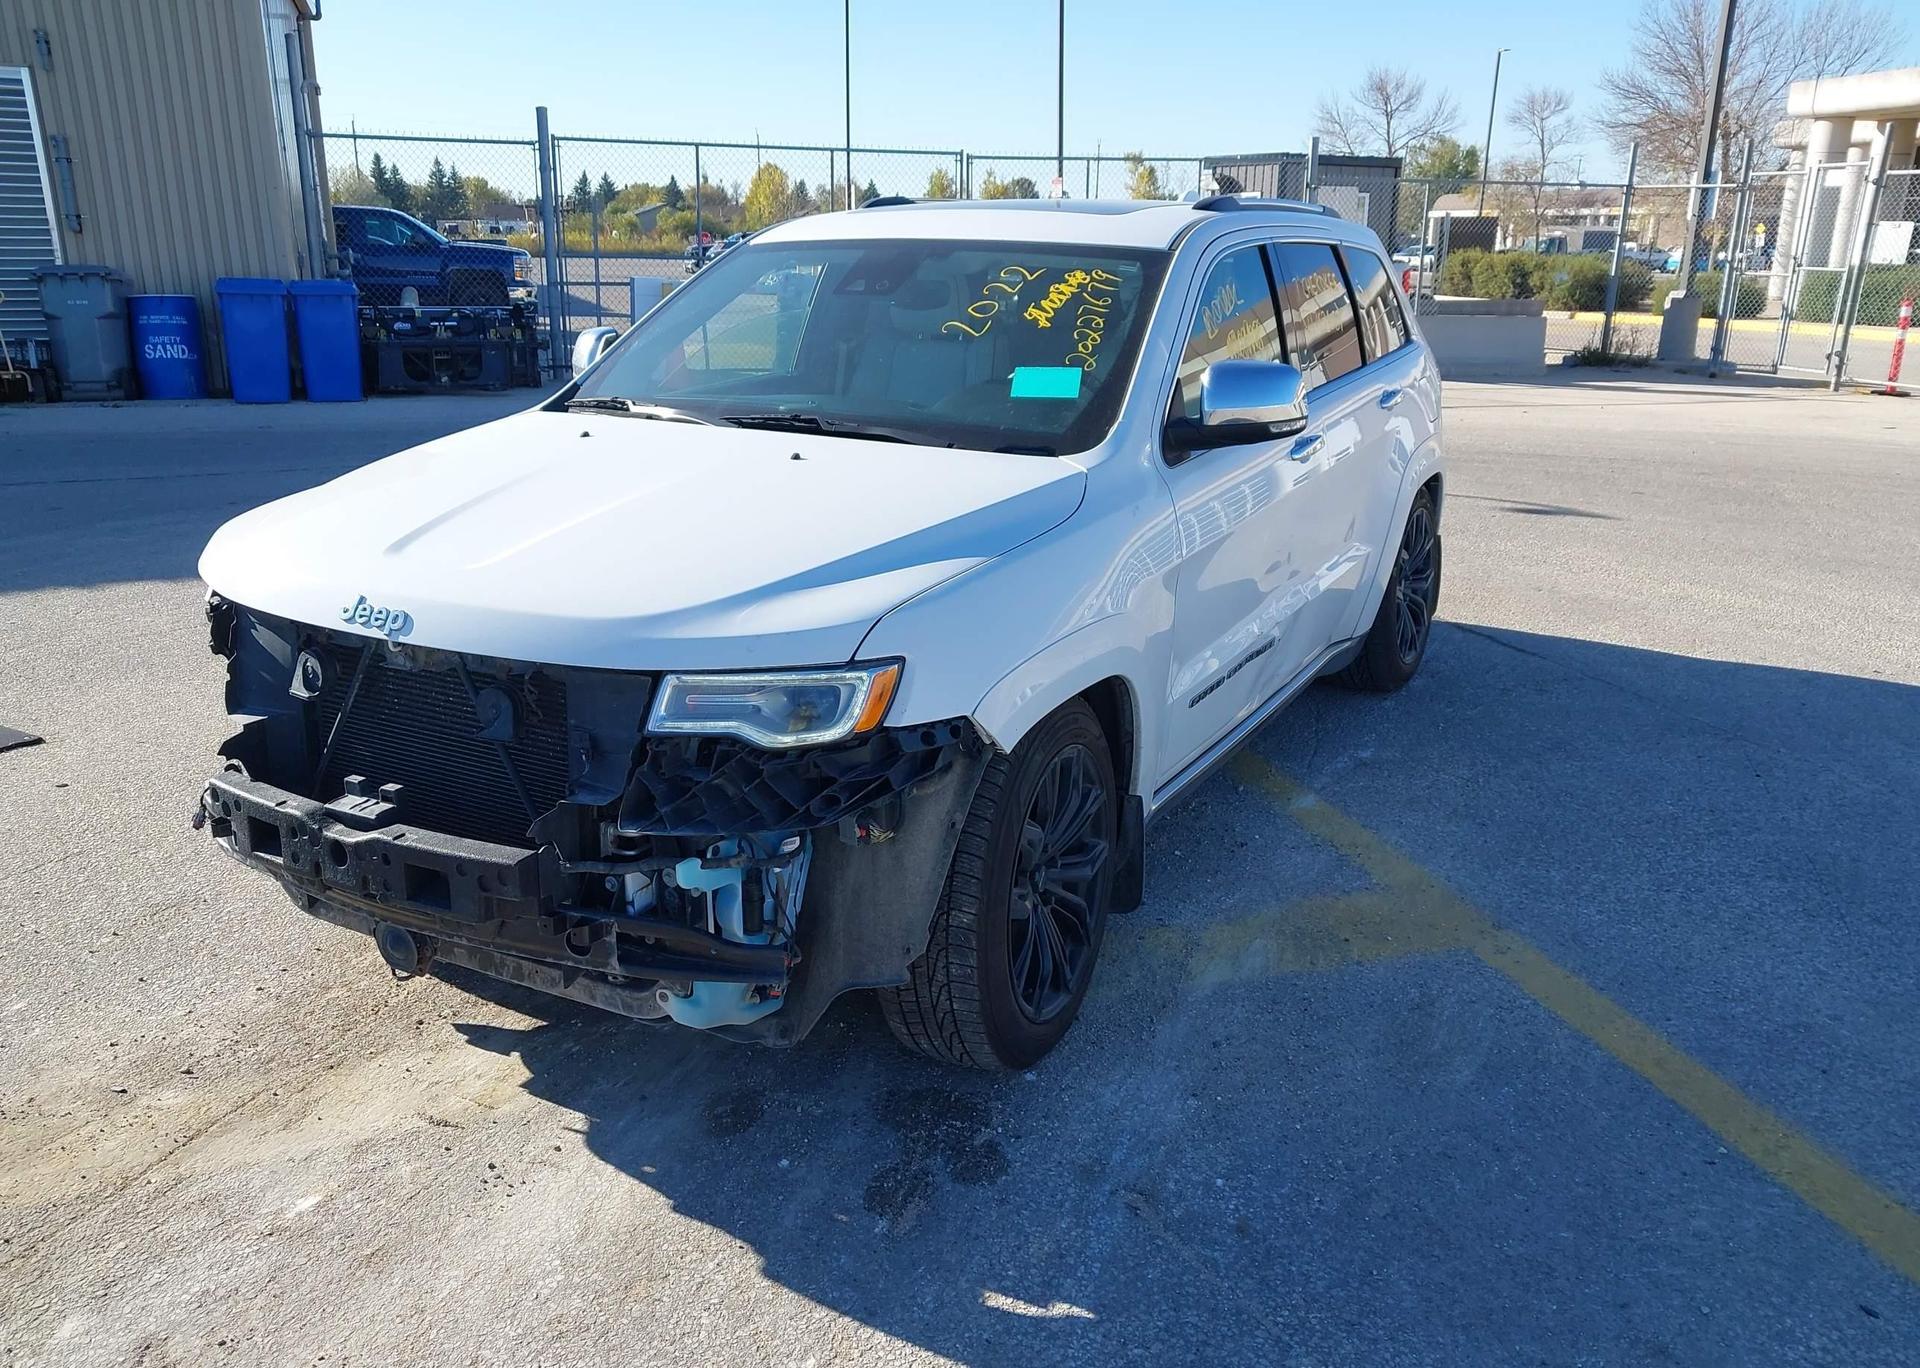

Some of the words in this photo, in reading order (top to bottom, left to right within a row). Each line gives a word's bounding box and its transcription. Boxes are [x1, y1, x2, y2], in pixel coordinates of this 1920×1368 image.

[941, 265, 1048, 337] 2022
[1066, 269, 1124, 371] 20227679
[148, 335, 181, 344] SAFETY
[337, 594, 406, 638] Jeep
